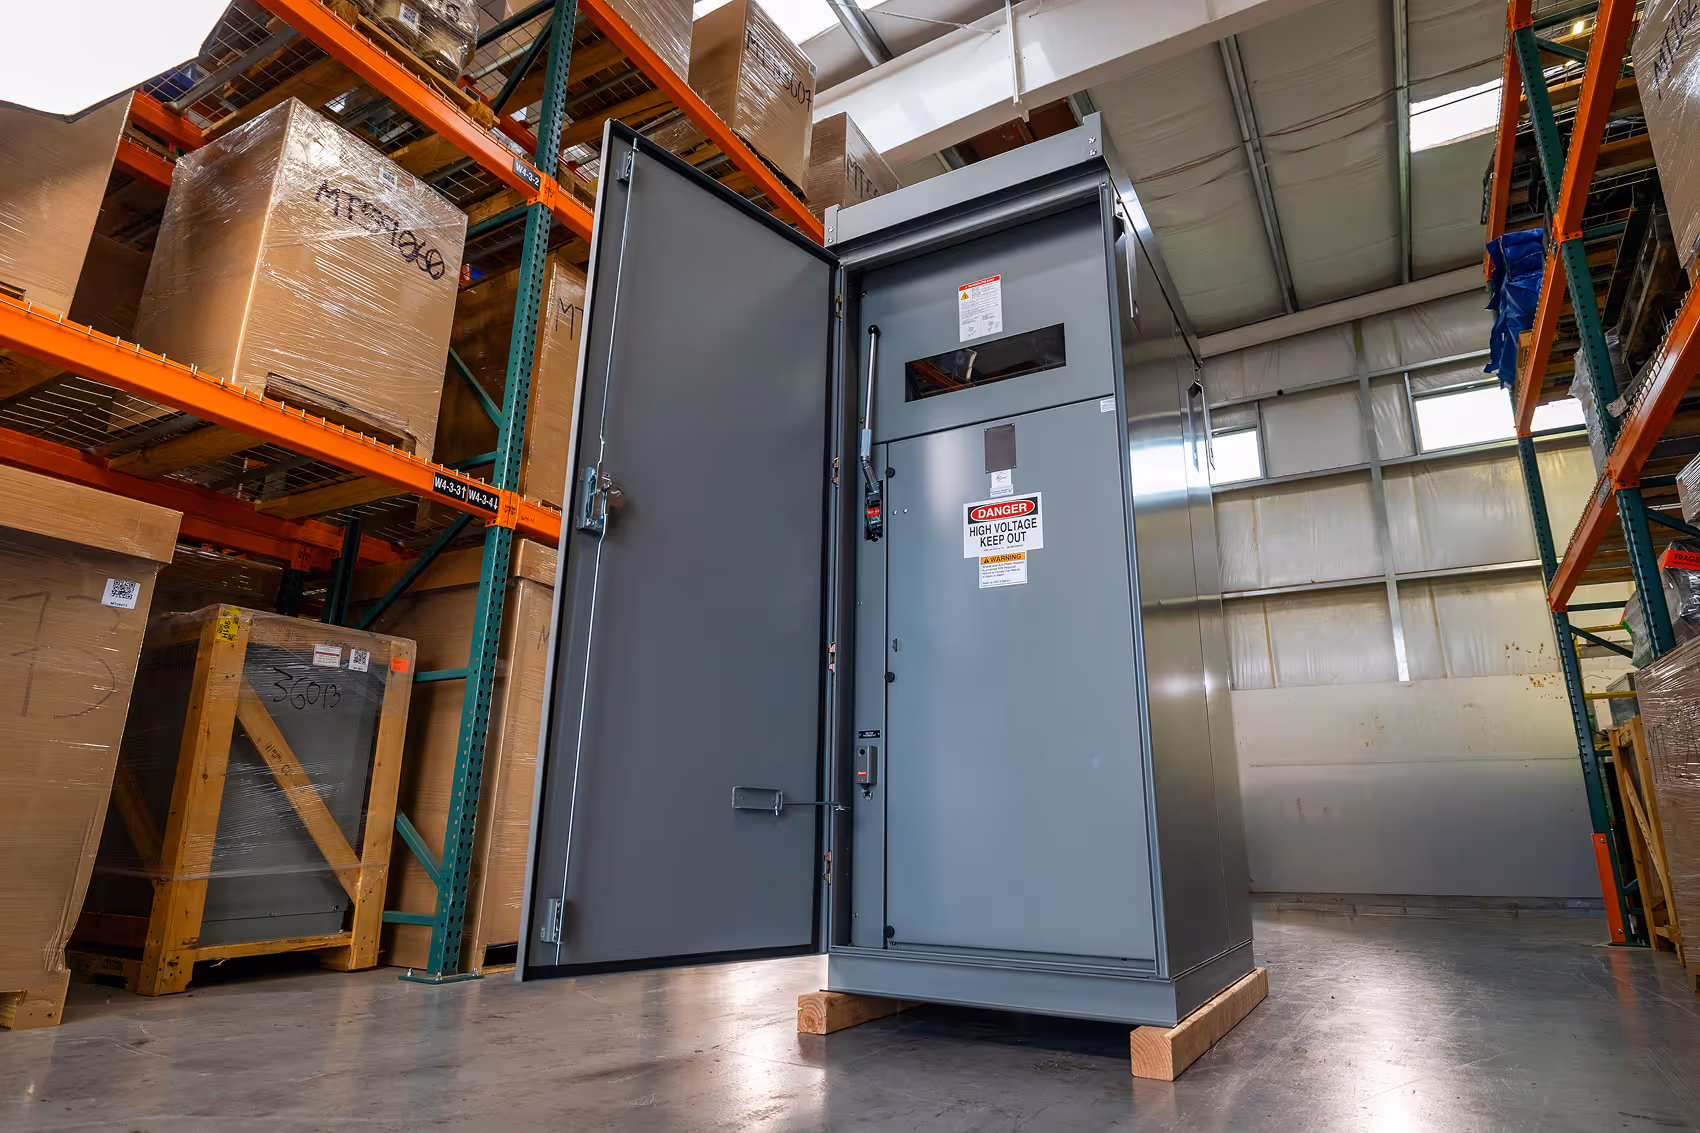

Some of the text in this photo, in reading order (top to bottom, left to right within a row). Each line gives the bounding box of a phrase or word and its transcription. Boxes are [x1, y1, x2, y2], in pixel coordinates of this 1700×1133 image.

[515, 162, 540, 187] W4-3-2
[978, 502, 1027, 519] DANGER
[969, 517, 1037, 537] HIGH VOLTAGE
[980, 531, 1027, 547] KEEP OUT
[990, 553, 1022, 563] WARNING
[273, 666, 341, 715] 36013
